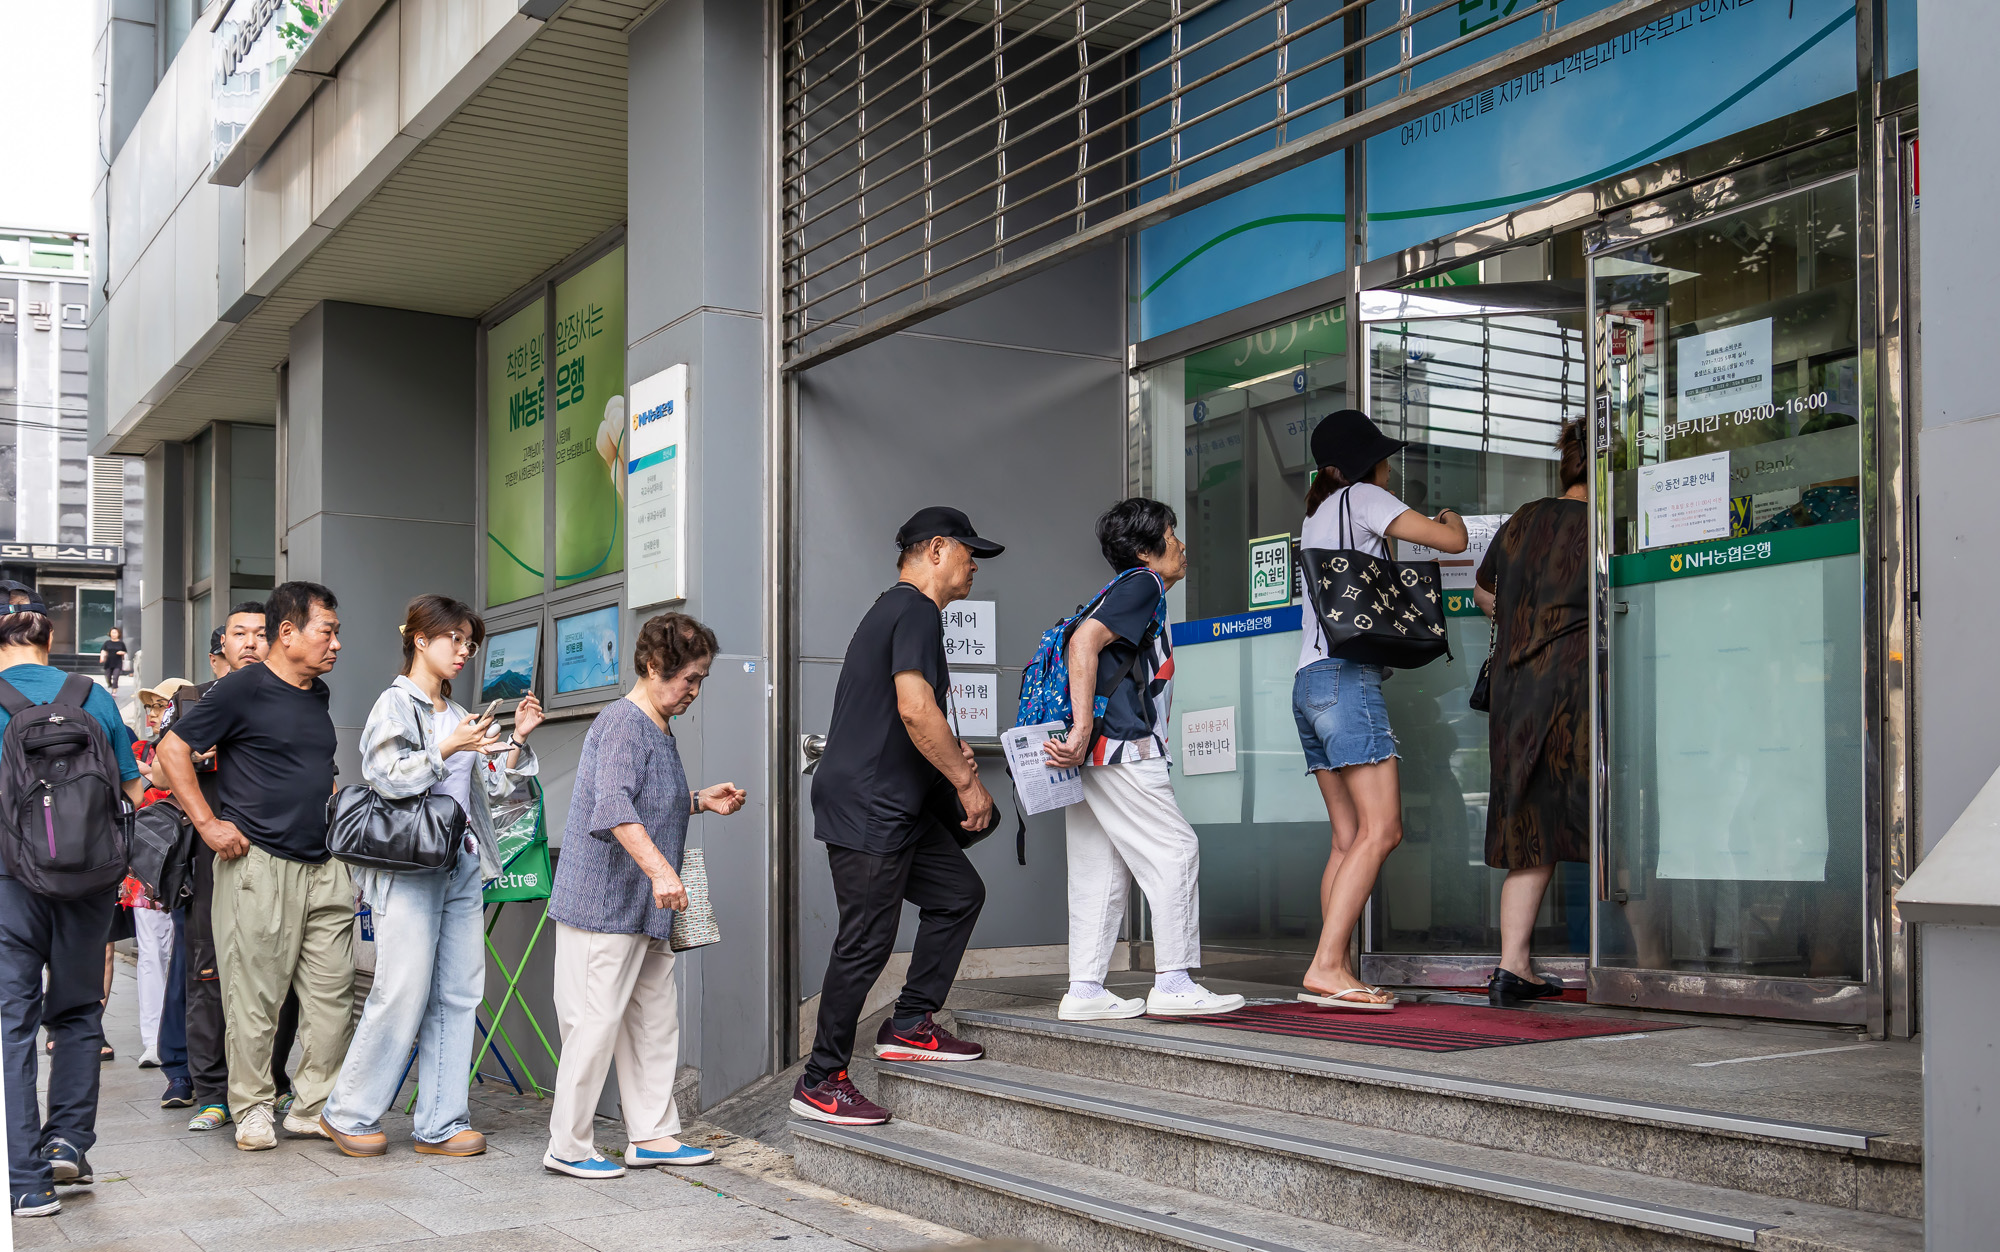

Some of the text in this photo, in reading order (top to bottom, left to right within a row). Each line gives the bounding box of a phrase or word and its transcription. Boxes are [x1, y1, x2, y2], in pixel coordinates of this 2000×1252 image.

[1401, 117, 1428, 146] 여기
[1432, 109, 1446, 133] 이
[1451, 89, 1494, 126] 자리를
[1499, 67, 1545, 106] 지키며
[1550, 38, 1617, 85] 고객님과
[507, 345, 529, 381] 착한
[556, 303, 604, 357] 앞장서는
[1663, 414, 1721, 441] 업무시간
[1734, 391, 1828, 425] 09:00~16:00
[1665, 477, 1680, 491] 동전
[1682, 475, 1697, 487] 교환
[1699, 471, 1715, 485] 안내
[0, 545, 114, 561] 모텔스타
[1254, 547, 1285, 568] 무더위
[1685, 541, 1771, 569] NH농협은행
[1268, 565, 1285, 582] 쉼터
[1221, 615, 1272, 635] NH농협은행
[1188, 718, 1229, 733] 도보이용금지
[1018, 751, 1038, 759] 가계대출
[1188, 738, 1231, 757] 위험합니다
